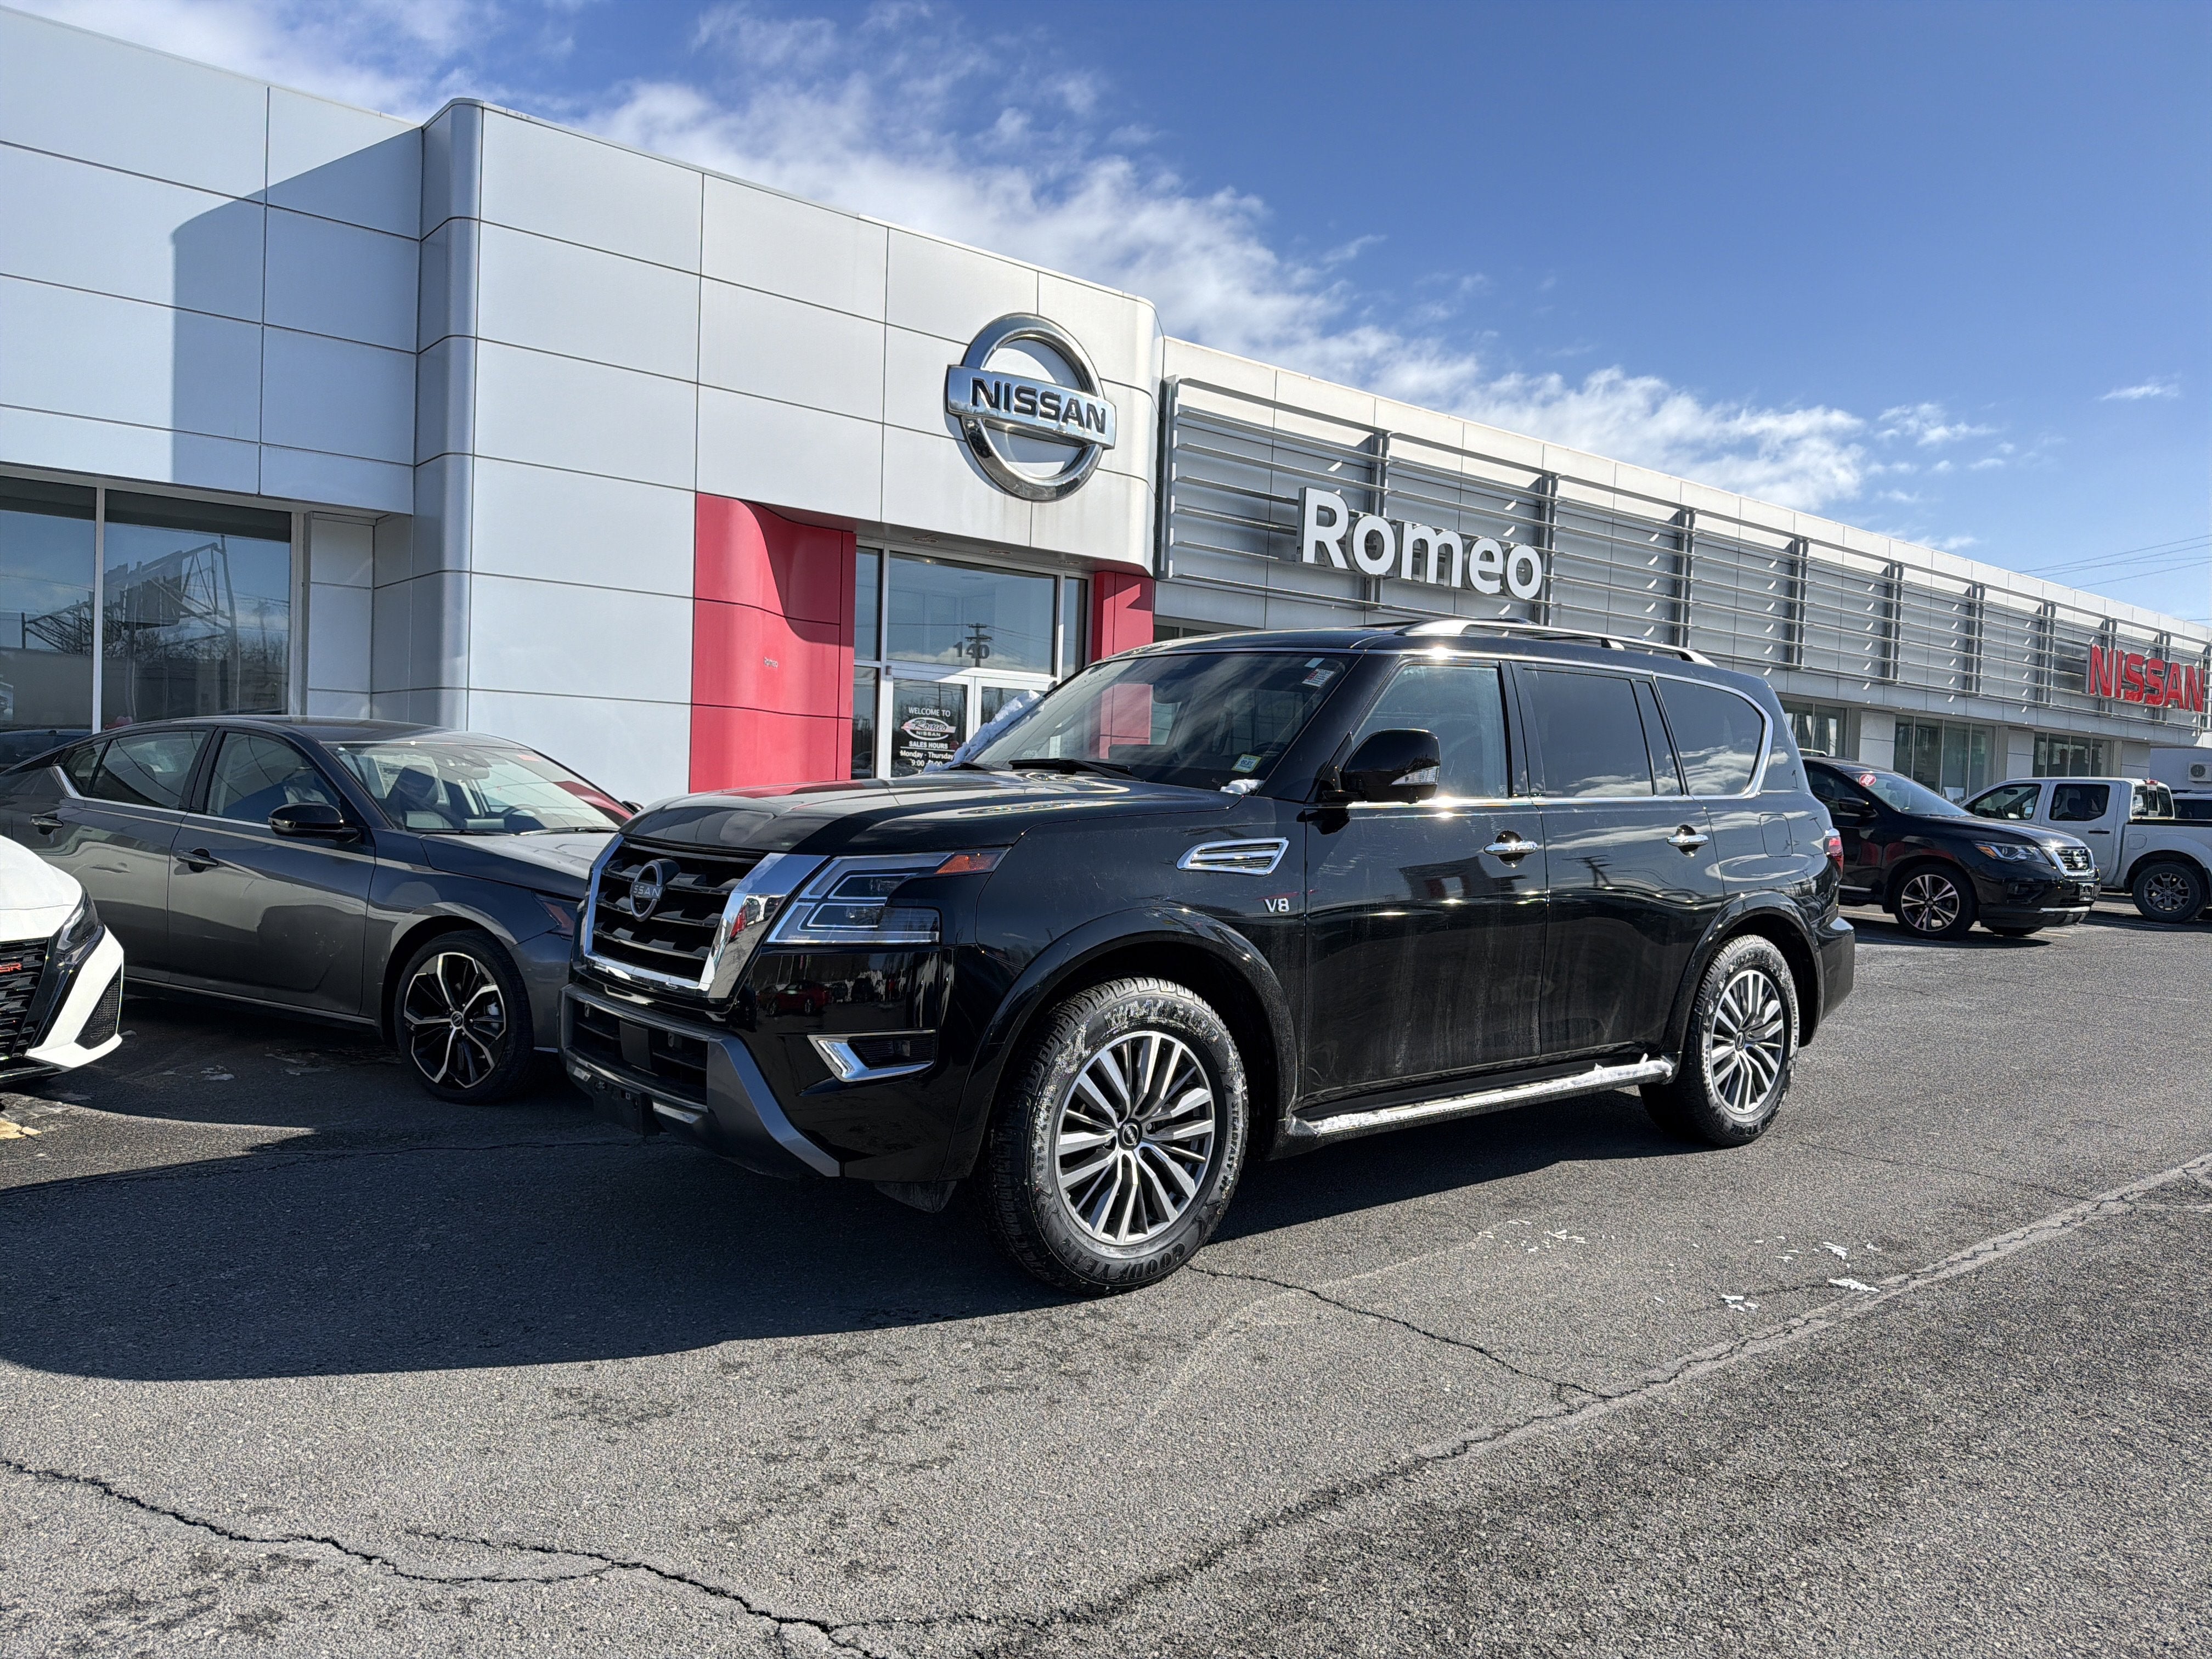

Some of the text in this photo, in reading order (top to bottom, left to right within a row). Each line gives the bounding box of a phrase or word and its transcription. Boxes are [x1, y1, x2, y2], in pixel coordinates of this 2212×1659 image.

[970, 377, 1107, 437] NISSAN
[1298, 486, 1543, 600] Romeo
[953, 641, 990, 659] 140
[2089, 644, 2205, 713] NISSAN
[909, 707, 940, 716] WELCOME
[912, 719, 947, 731] Romeo
[900, 749, 923, 759] Monday
[927, 751, 954, 761] Thursday
[911, 759, 925, 767] 9:00
[1263, 898, 1290, 913] V8
